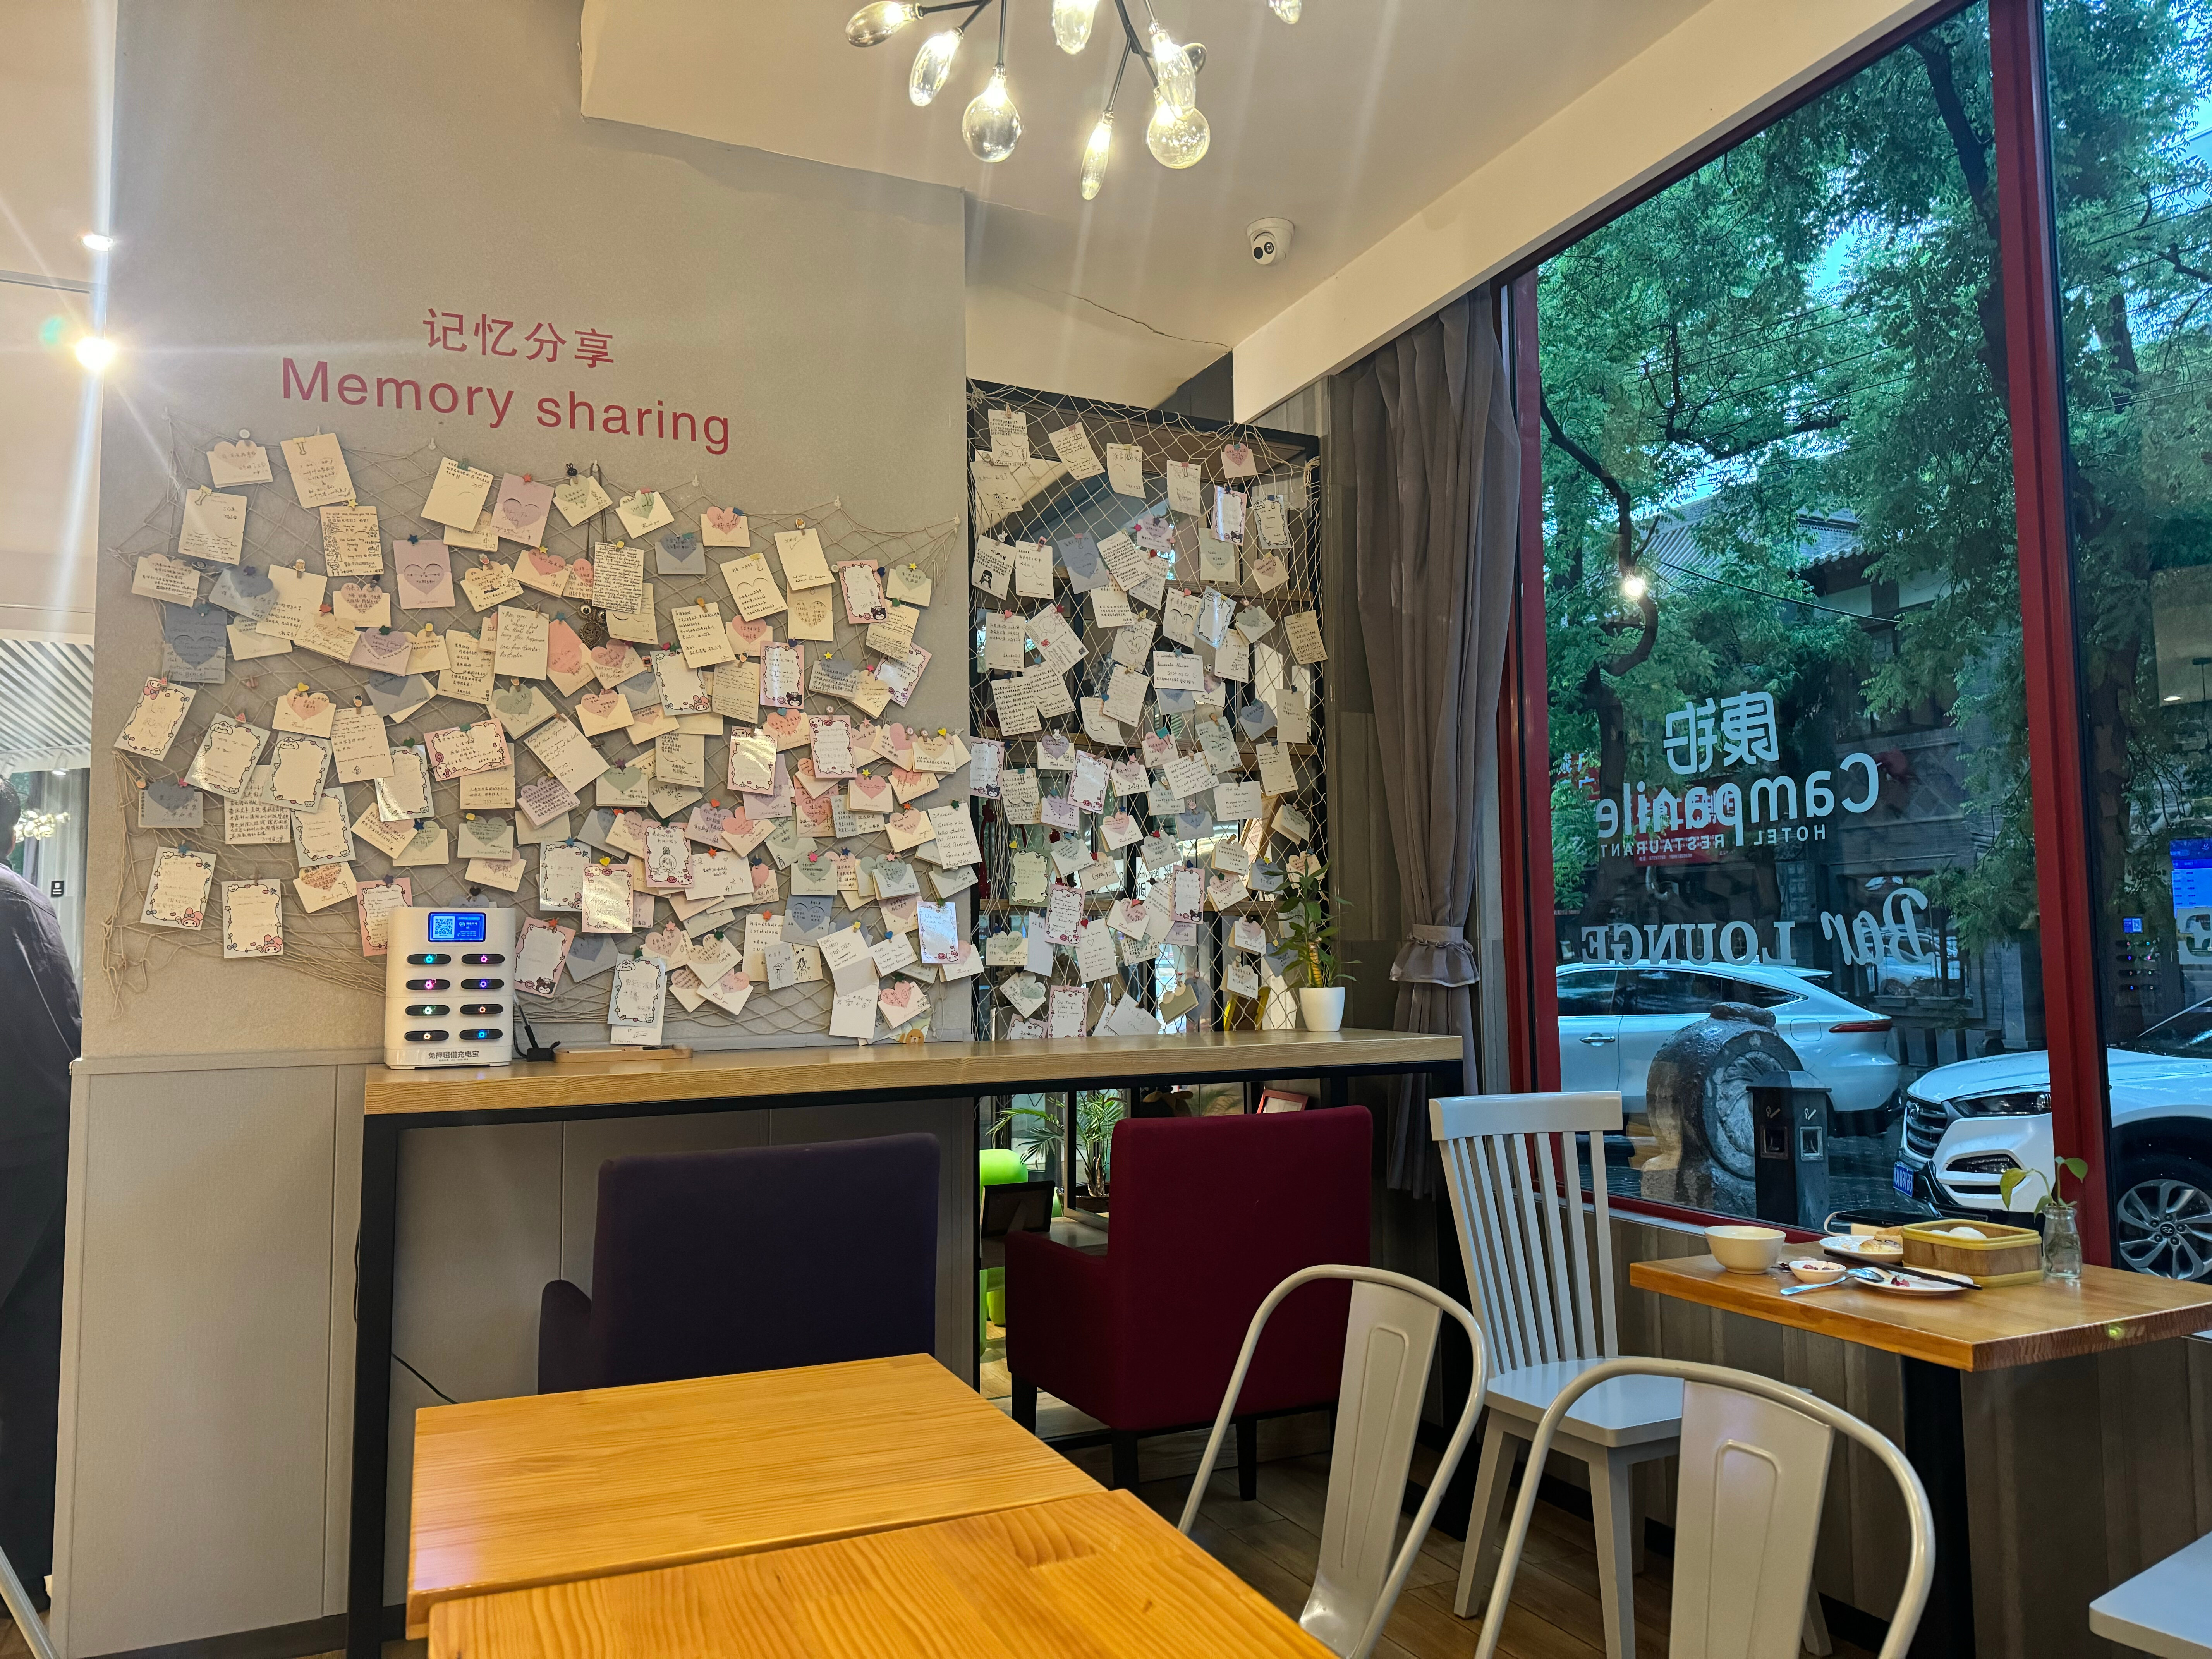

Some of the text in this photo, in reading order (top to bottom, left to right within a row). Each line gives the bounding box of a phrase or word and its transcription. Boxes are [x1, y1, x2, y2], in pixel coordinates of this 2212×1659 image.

[422, 307, 615, 369] 记忆分享
[282, 358, 729, 455] Memory sharing
